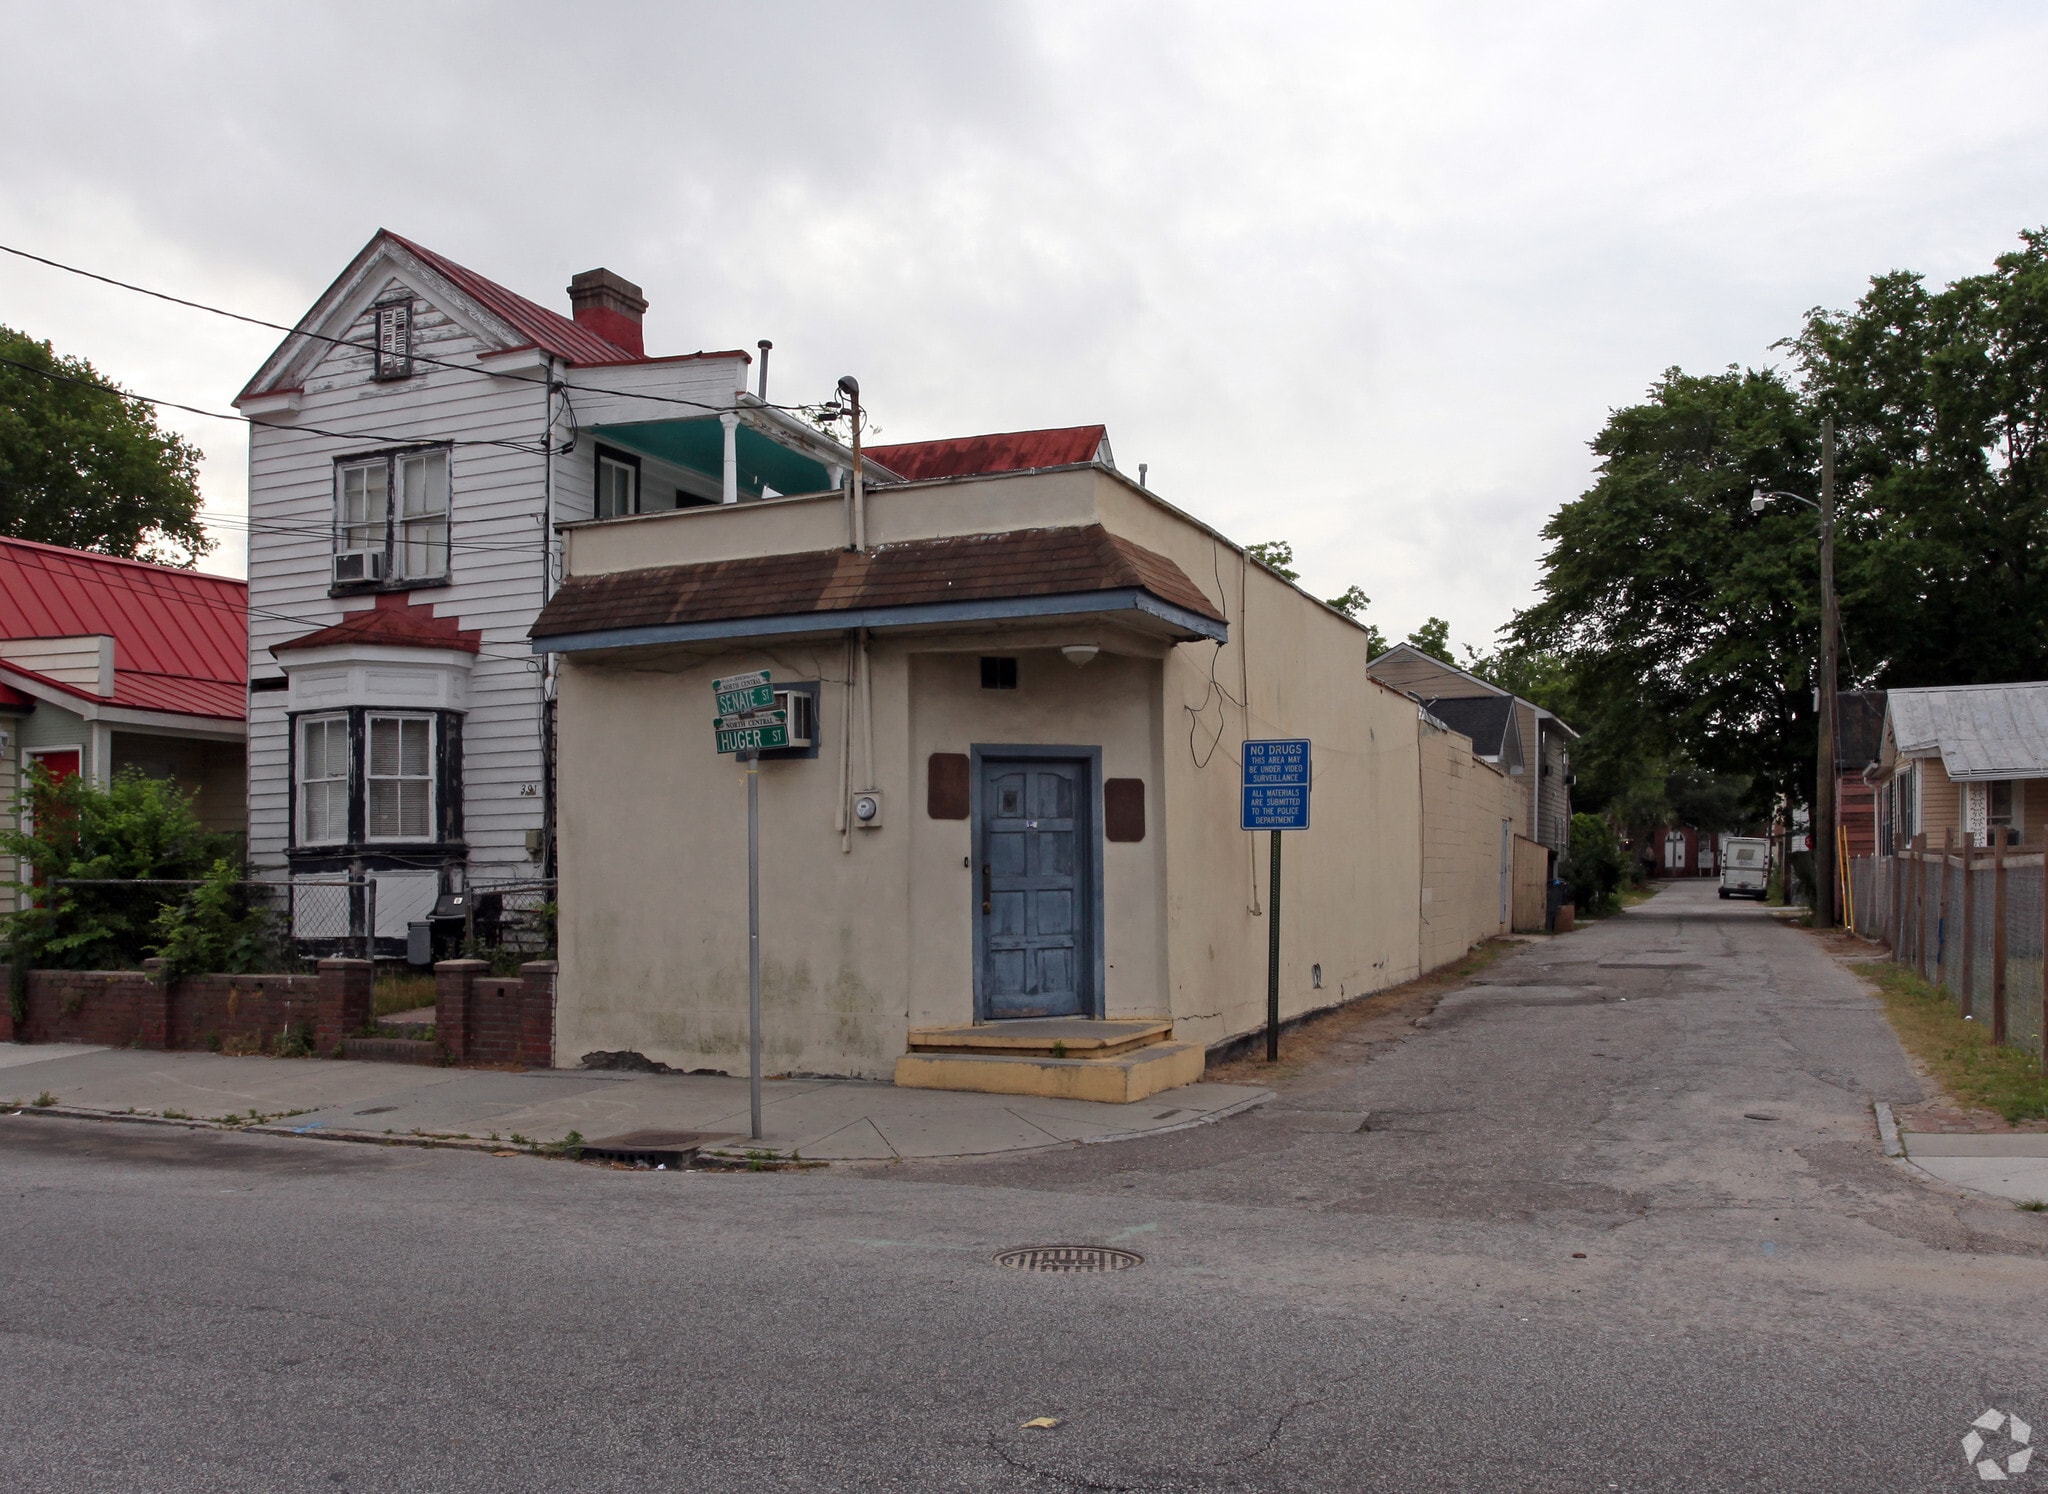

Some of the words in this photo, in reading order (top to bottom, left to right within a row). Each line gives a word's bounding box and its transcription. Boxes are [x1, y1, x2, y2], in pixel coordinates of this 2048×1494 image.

[741, 678, 761, 687] CENTRAL
[720, 690, 757, 713] SENATE
[762, 689, 770, 700] ST
[721, 730, 762, 750] HUGER
[772, 730, 782, 742] ST
[1250, 746, 1264, 755] NO
[1269, 745, 1302, 754] DRUGS
